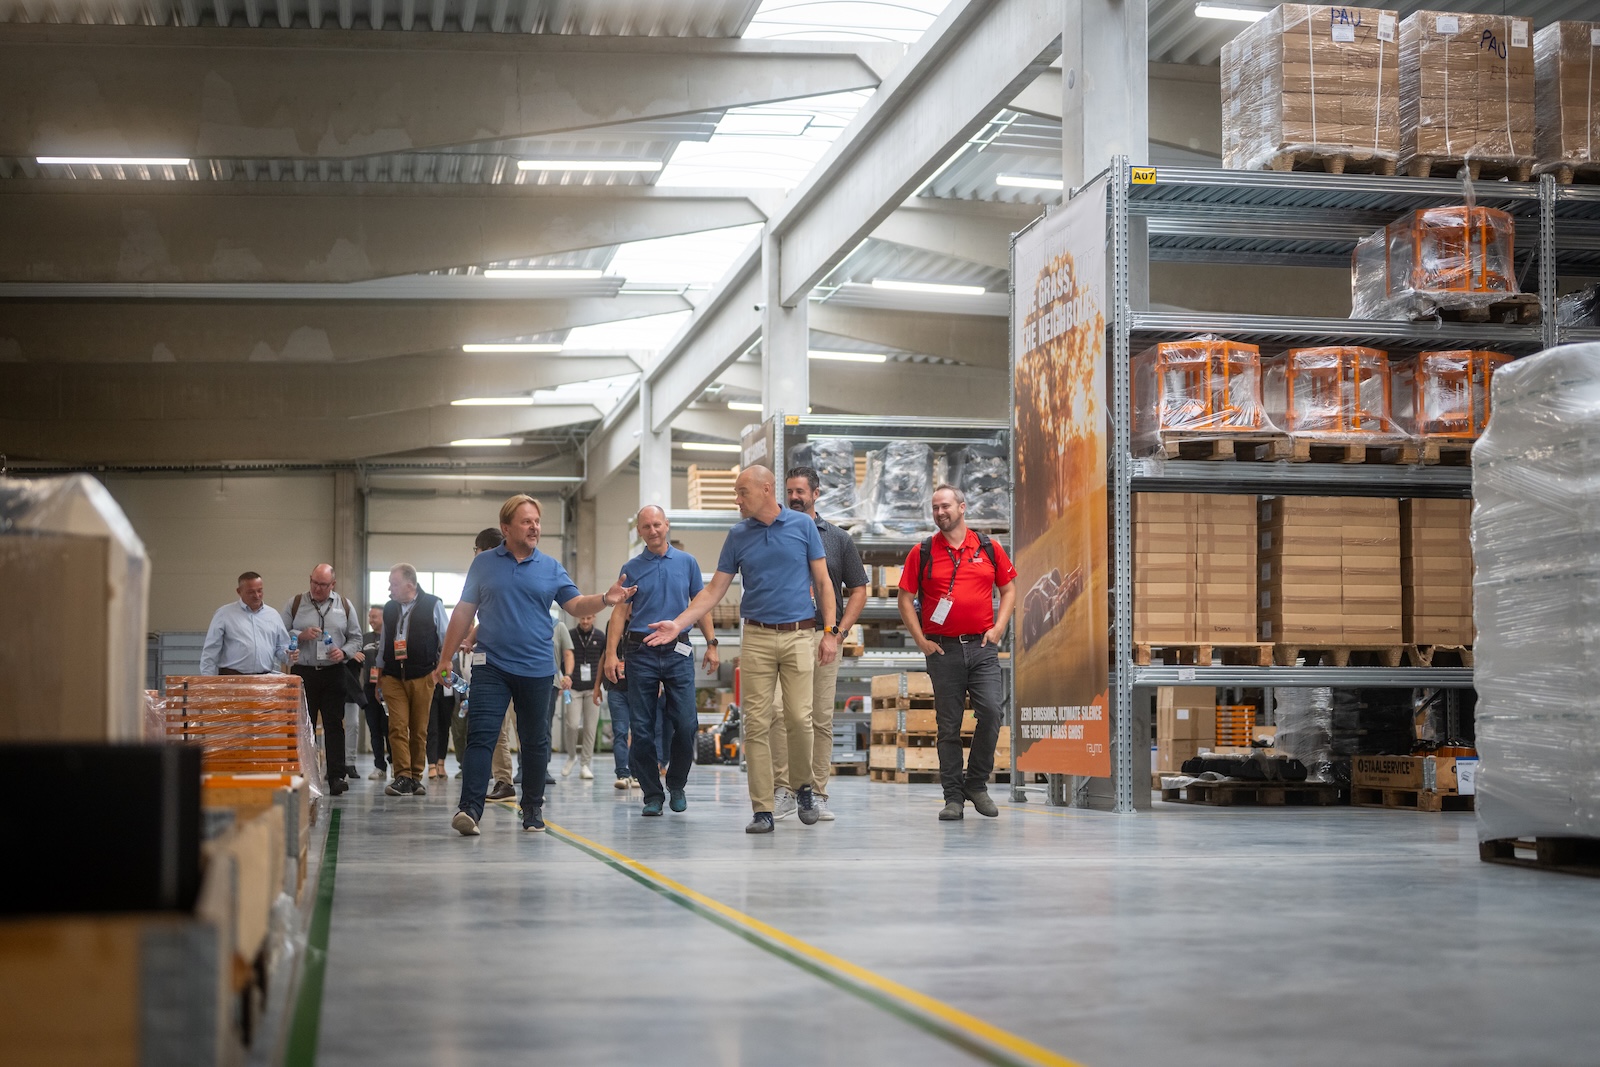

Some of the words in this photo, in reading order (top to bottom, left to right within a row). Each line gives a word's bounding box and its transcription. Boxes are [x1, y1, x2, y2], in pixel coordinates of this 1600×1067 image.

[1331, 7, 1361, 27] PAU
[1480, 29, 1507, 59] PAU
[1133, 172, 1155, 180] A07
[1039, 263, 1074, 309] GRASS,
[1022, 320, 1037, 354] THE
[1038, 284, 1100, 347] NEIGHBOURS
[1021, 707, 1032, 721] ZERO
[1058, 706, 1081, 721] ULTIMATE
[1082, 705, 1102, 721] SILENCE
[1021, 725, 1030, 738] THE
[1052, 725, 1067, 739] GRASS
